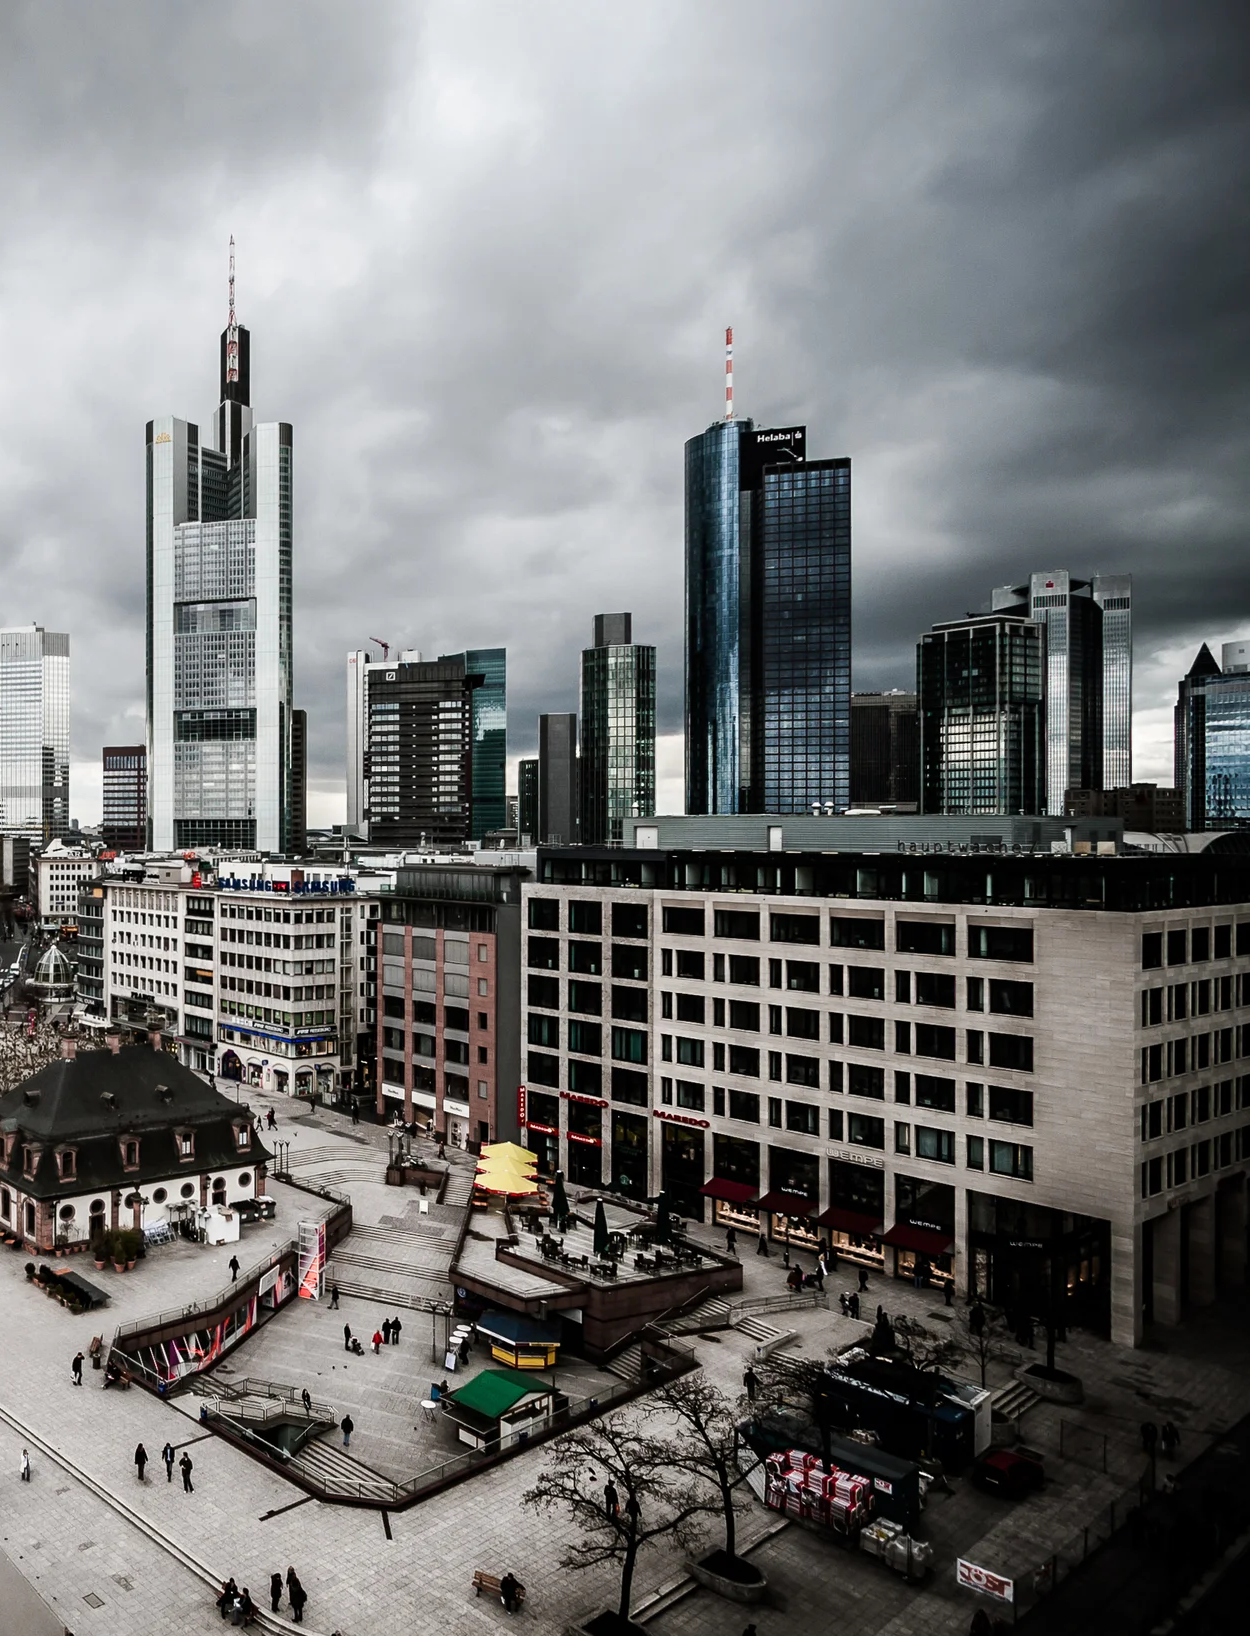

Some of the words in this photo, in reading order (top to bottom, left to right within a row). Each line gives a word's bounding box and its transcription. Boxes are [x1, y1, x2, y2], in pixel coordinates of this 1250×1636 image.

[757, 433, 791, 443] Helaba
[897, 840, 1022, 853] hauptwache
[218, 877, 272, 892] SAMSUNG
[294, 878, 356, 893] SAMSUNG
[559, 1091, 609, 1108] MAREDO
[653, 1109, 711, 1128] MAREDO
[826, 1147, 884, 1168] WEMPE
[781, 1186, 808, 1198] WEMPE
[909, 1218, 942, 1231] WEMPE
